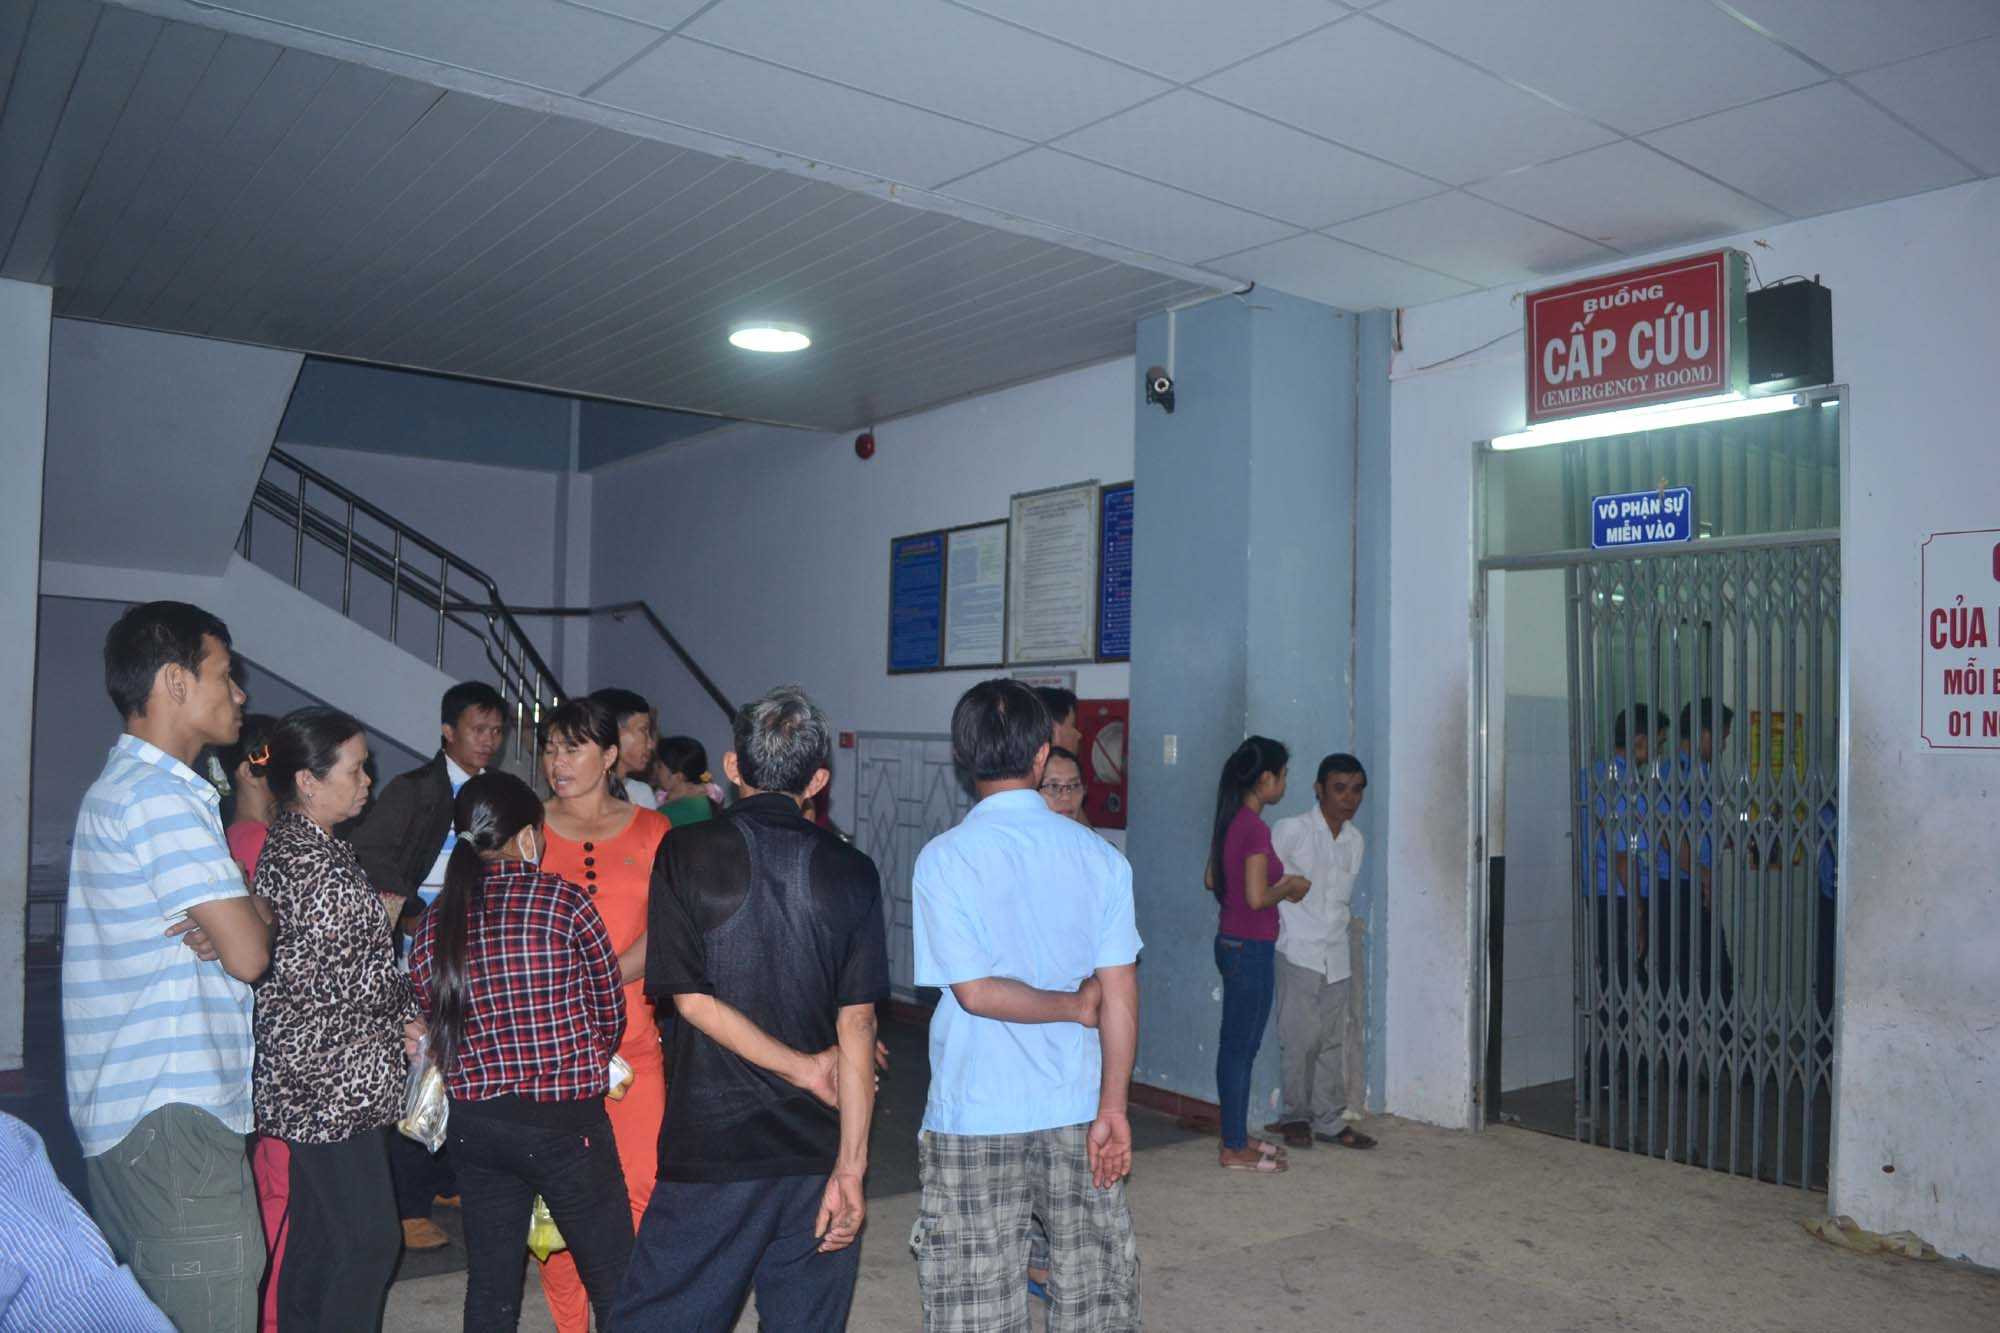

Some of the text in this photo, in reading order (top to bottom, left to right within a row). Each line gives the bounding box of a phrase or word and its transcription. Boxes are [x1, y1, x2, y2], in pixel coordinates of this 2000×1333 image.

[1543, 302, 1709, 384] CẤP CỨU
[1542, 366, 1712, 407] (EMERGENCY ROOM)
[1599, 493, 1685, 520] VÔ PHẬN SỰ
[1645, 519, 1675, 539] VÀO
[1930, 594, 1987, 650] CỦA
[1943, 657, 1985, 695] MỖI
[1948, 710, 1971, 737] 01
